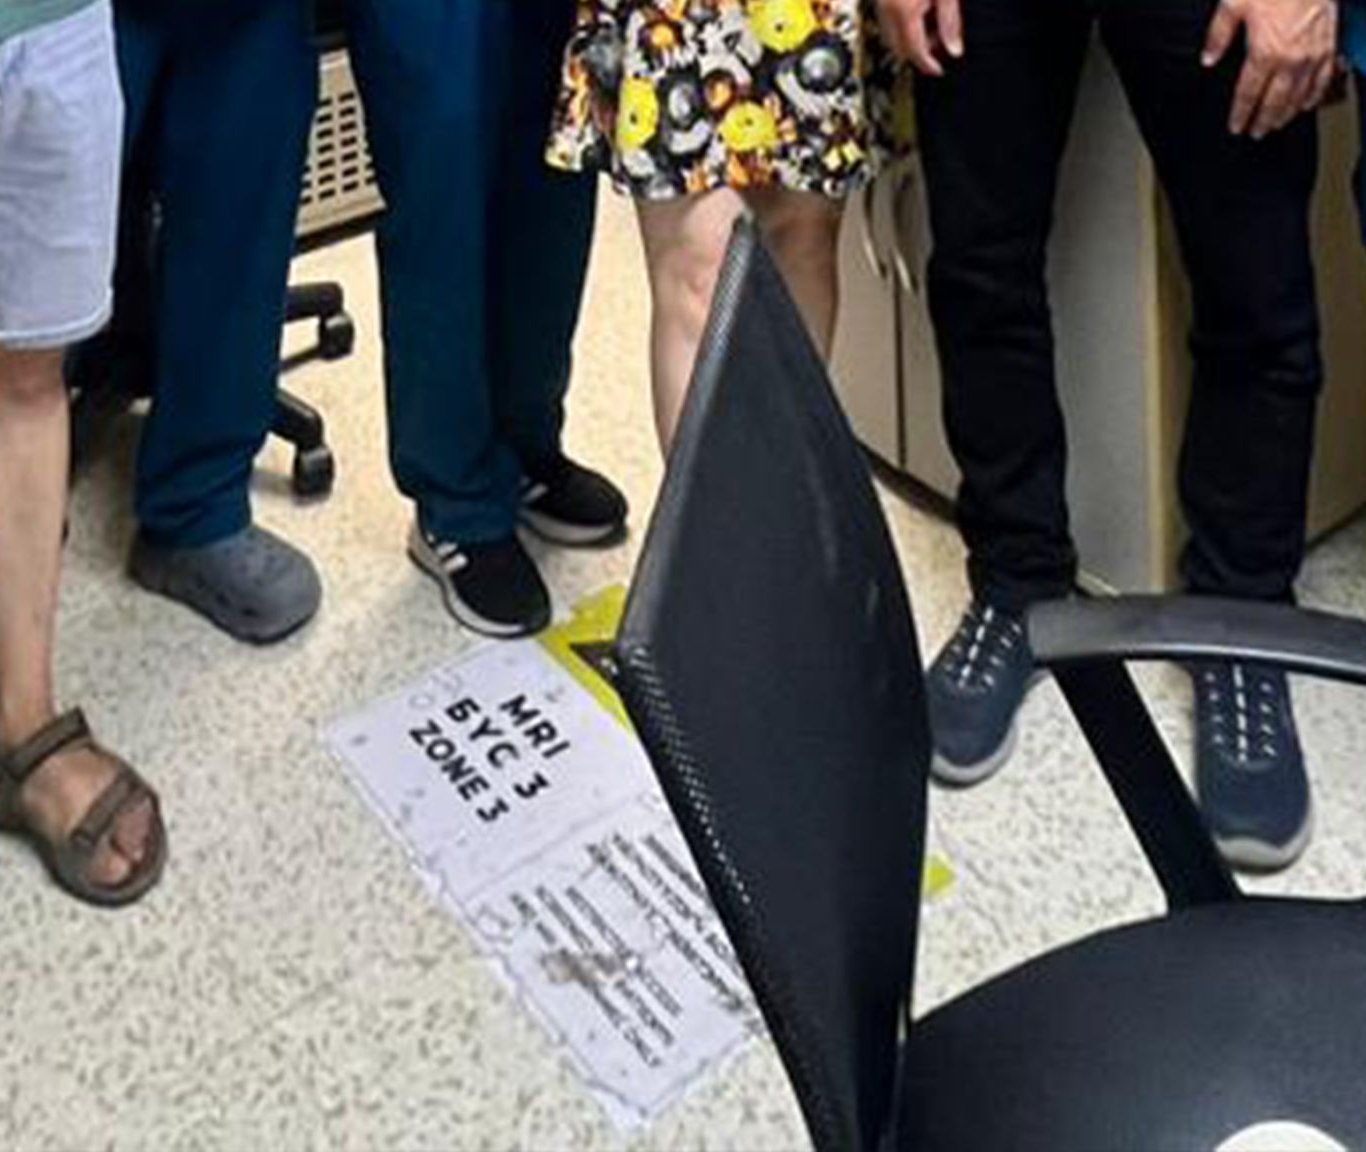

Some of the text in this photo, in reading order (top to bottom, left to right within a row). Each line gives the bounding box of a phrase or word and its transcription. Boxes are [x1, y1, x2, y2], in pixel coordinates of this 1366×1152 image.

[499, 693, 571, 759] MRI
[409, 719, 510, 823] ZONE 3
[513, 772, 550, 799] 3
